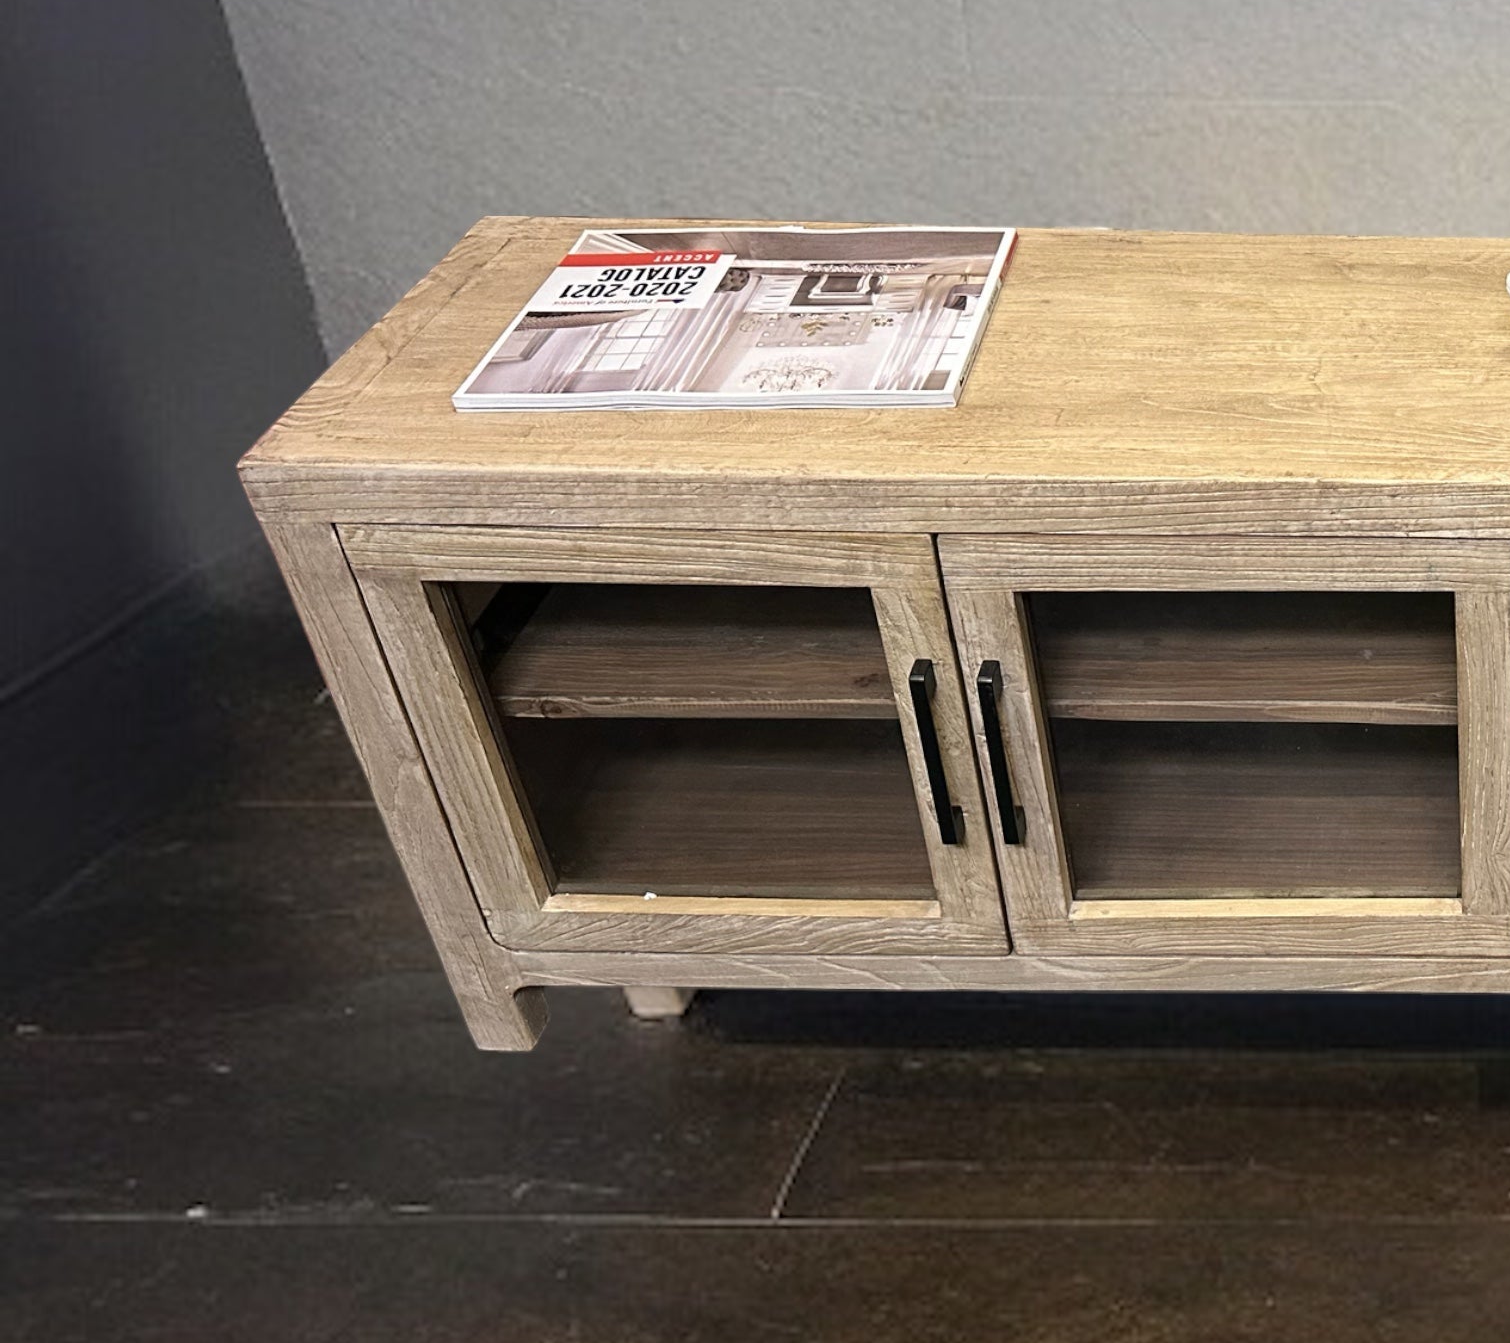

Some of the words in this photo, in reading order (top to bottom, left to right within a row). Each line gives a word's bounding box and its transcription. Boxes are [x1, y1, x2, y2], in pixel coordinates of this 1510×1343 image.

[653, 254, 714, 263] ACCENT
[597, 266, 706, 282] CATALOG
[559, 282, 698, 299] 2020-2021
